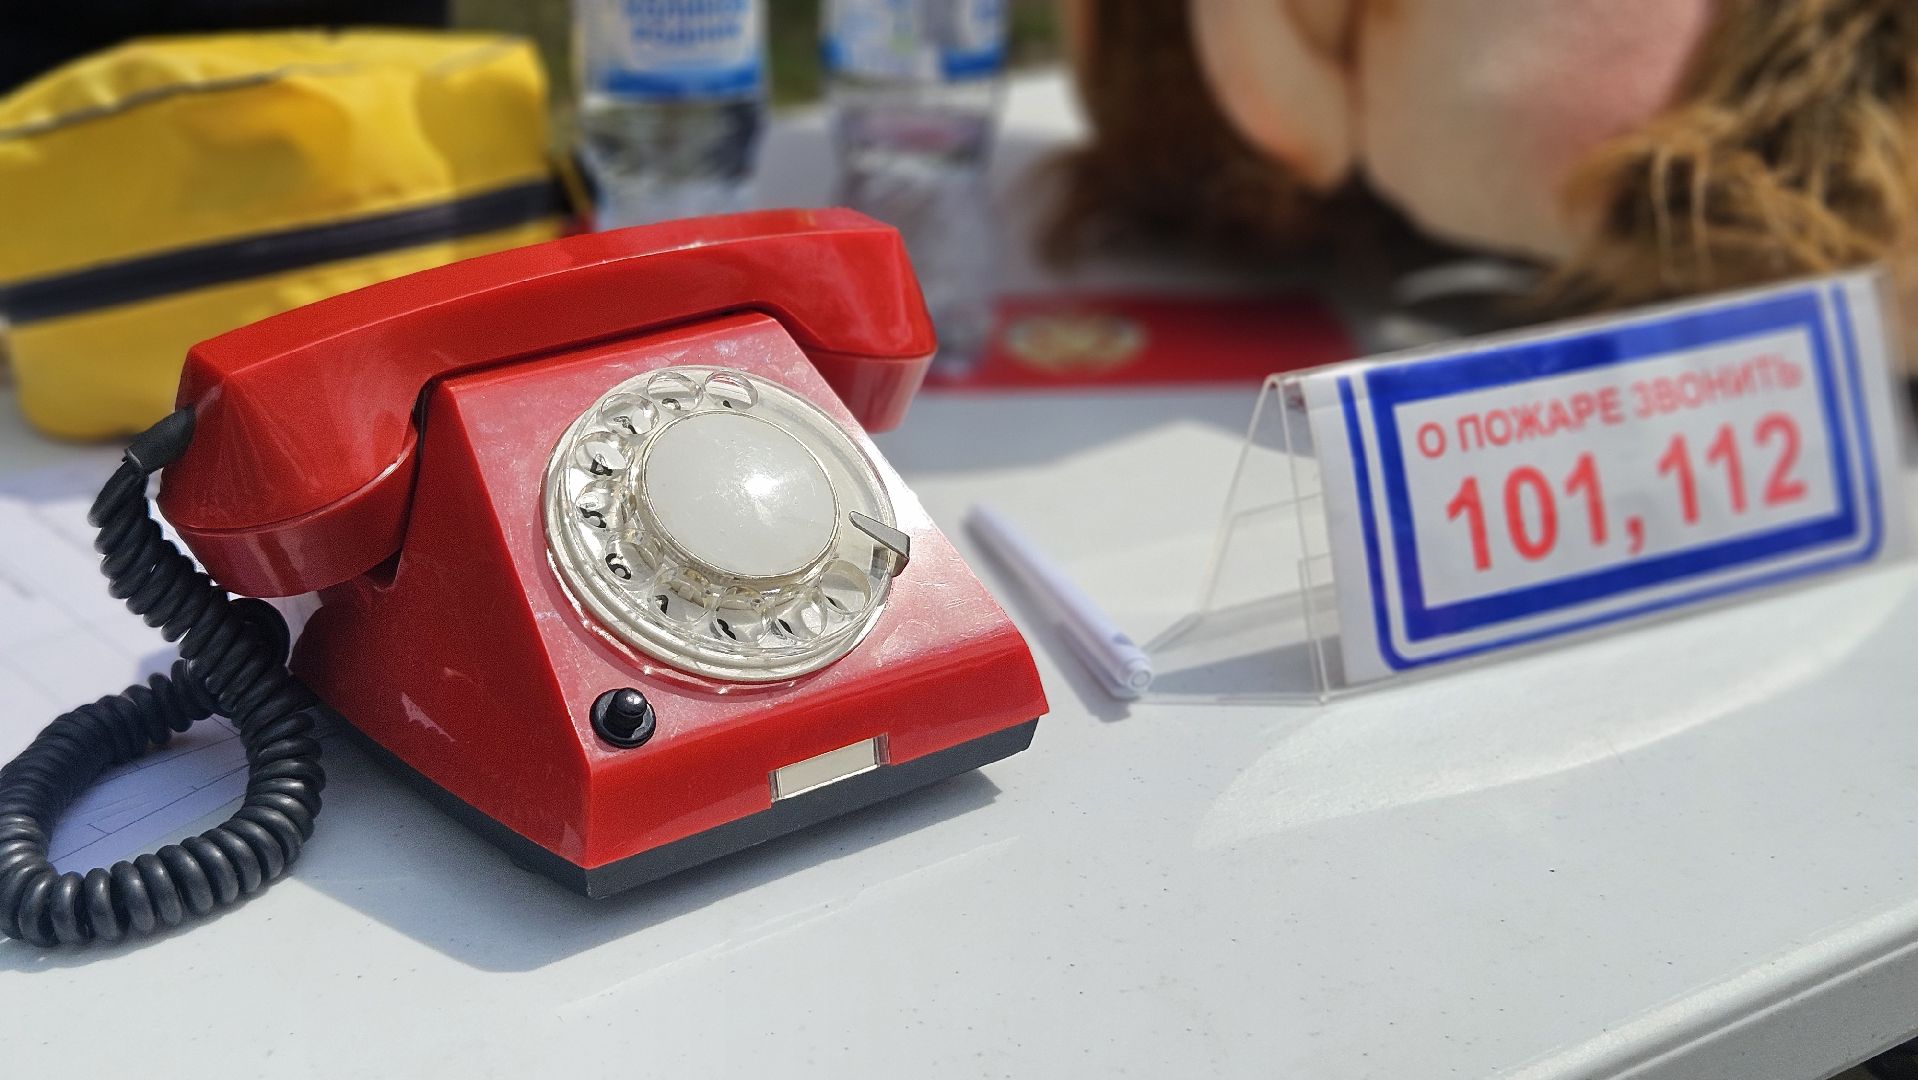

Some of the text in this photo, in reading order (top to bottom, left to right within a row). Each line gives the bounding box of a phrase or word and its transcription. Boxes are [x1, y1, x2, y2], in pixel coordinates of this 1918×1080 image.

[1417, 352, 1804, 458] О ПОЖАРЕ ЗВОНИТЬ
[605, 553, 632, 580] 6
